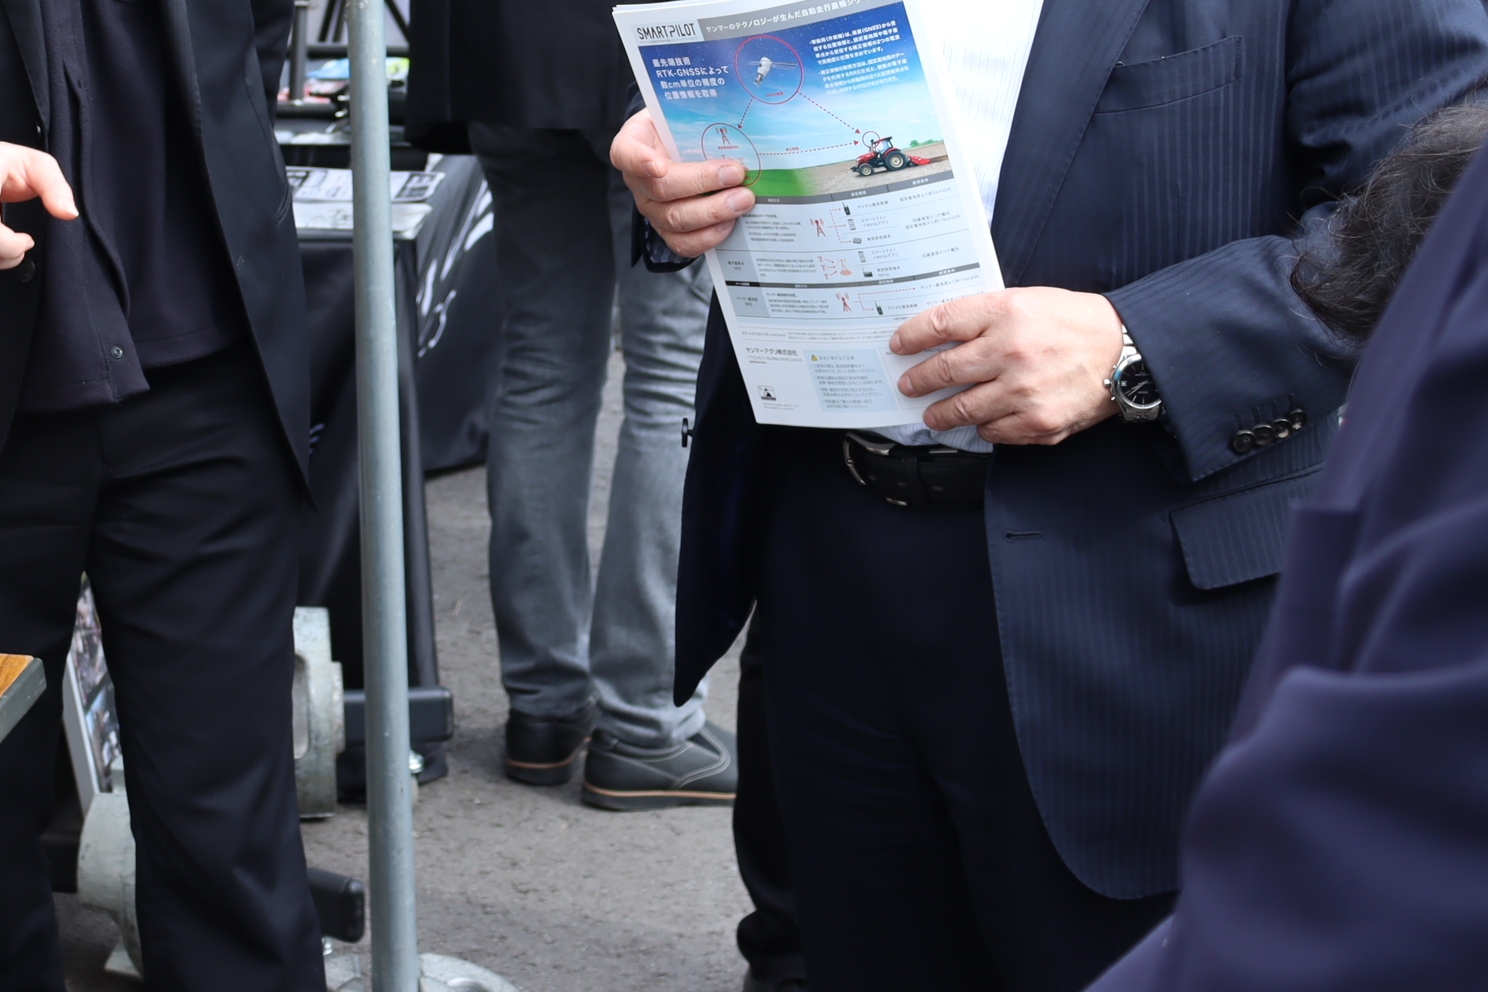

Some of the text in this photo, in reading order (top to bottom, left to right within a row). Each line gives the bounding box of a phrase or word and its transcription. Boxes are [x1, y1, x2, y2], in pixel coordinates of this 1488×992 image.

[652, 56, 691, 68] 最先端技術
[656, 65, 729, 78] RTK-GNSSによって
[660, 77, 725, 89] 数cm単位の精度の
[664, 89, 718, 100] 位置情報を取得
